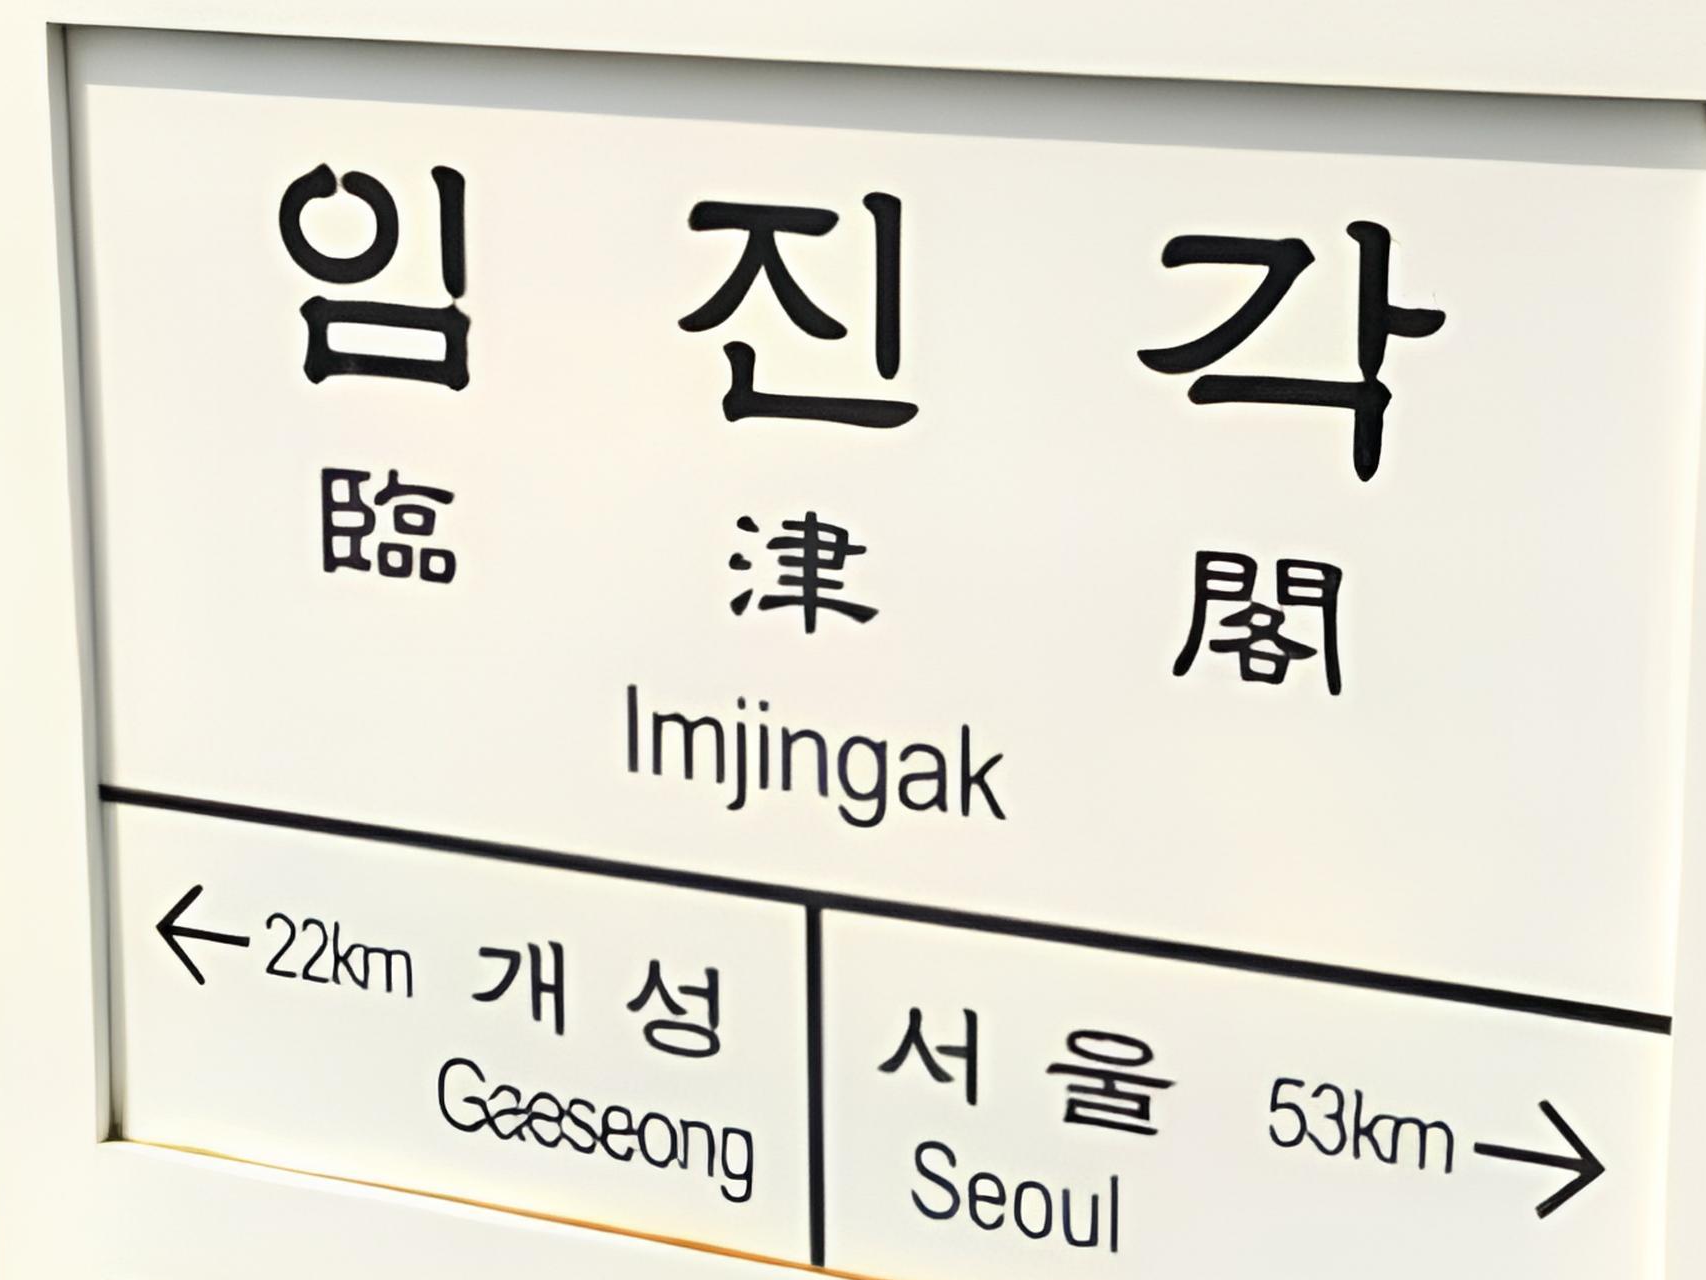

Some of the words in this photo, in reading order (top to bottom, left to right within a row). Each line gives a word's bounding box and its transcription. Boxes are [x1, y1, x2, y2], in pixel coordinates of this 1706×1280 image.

[625, 682, 1008, 830] Imjingak
[262, 910, 415, 1000] 22km
[470, 939, 723, 1060] 개성
[435, 1055, 757, 1205] Gaeseong
[876, 1005, 1177, 1138] 서울
[1267, 1075, 1456, 1176] 53km
[909, 1138, 1122, 1255] Seoul
